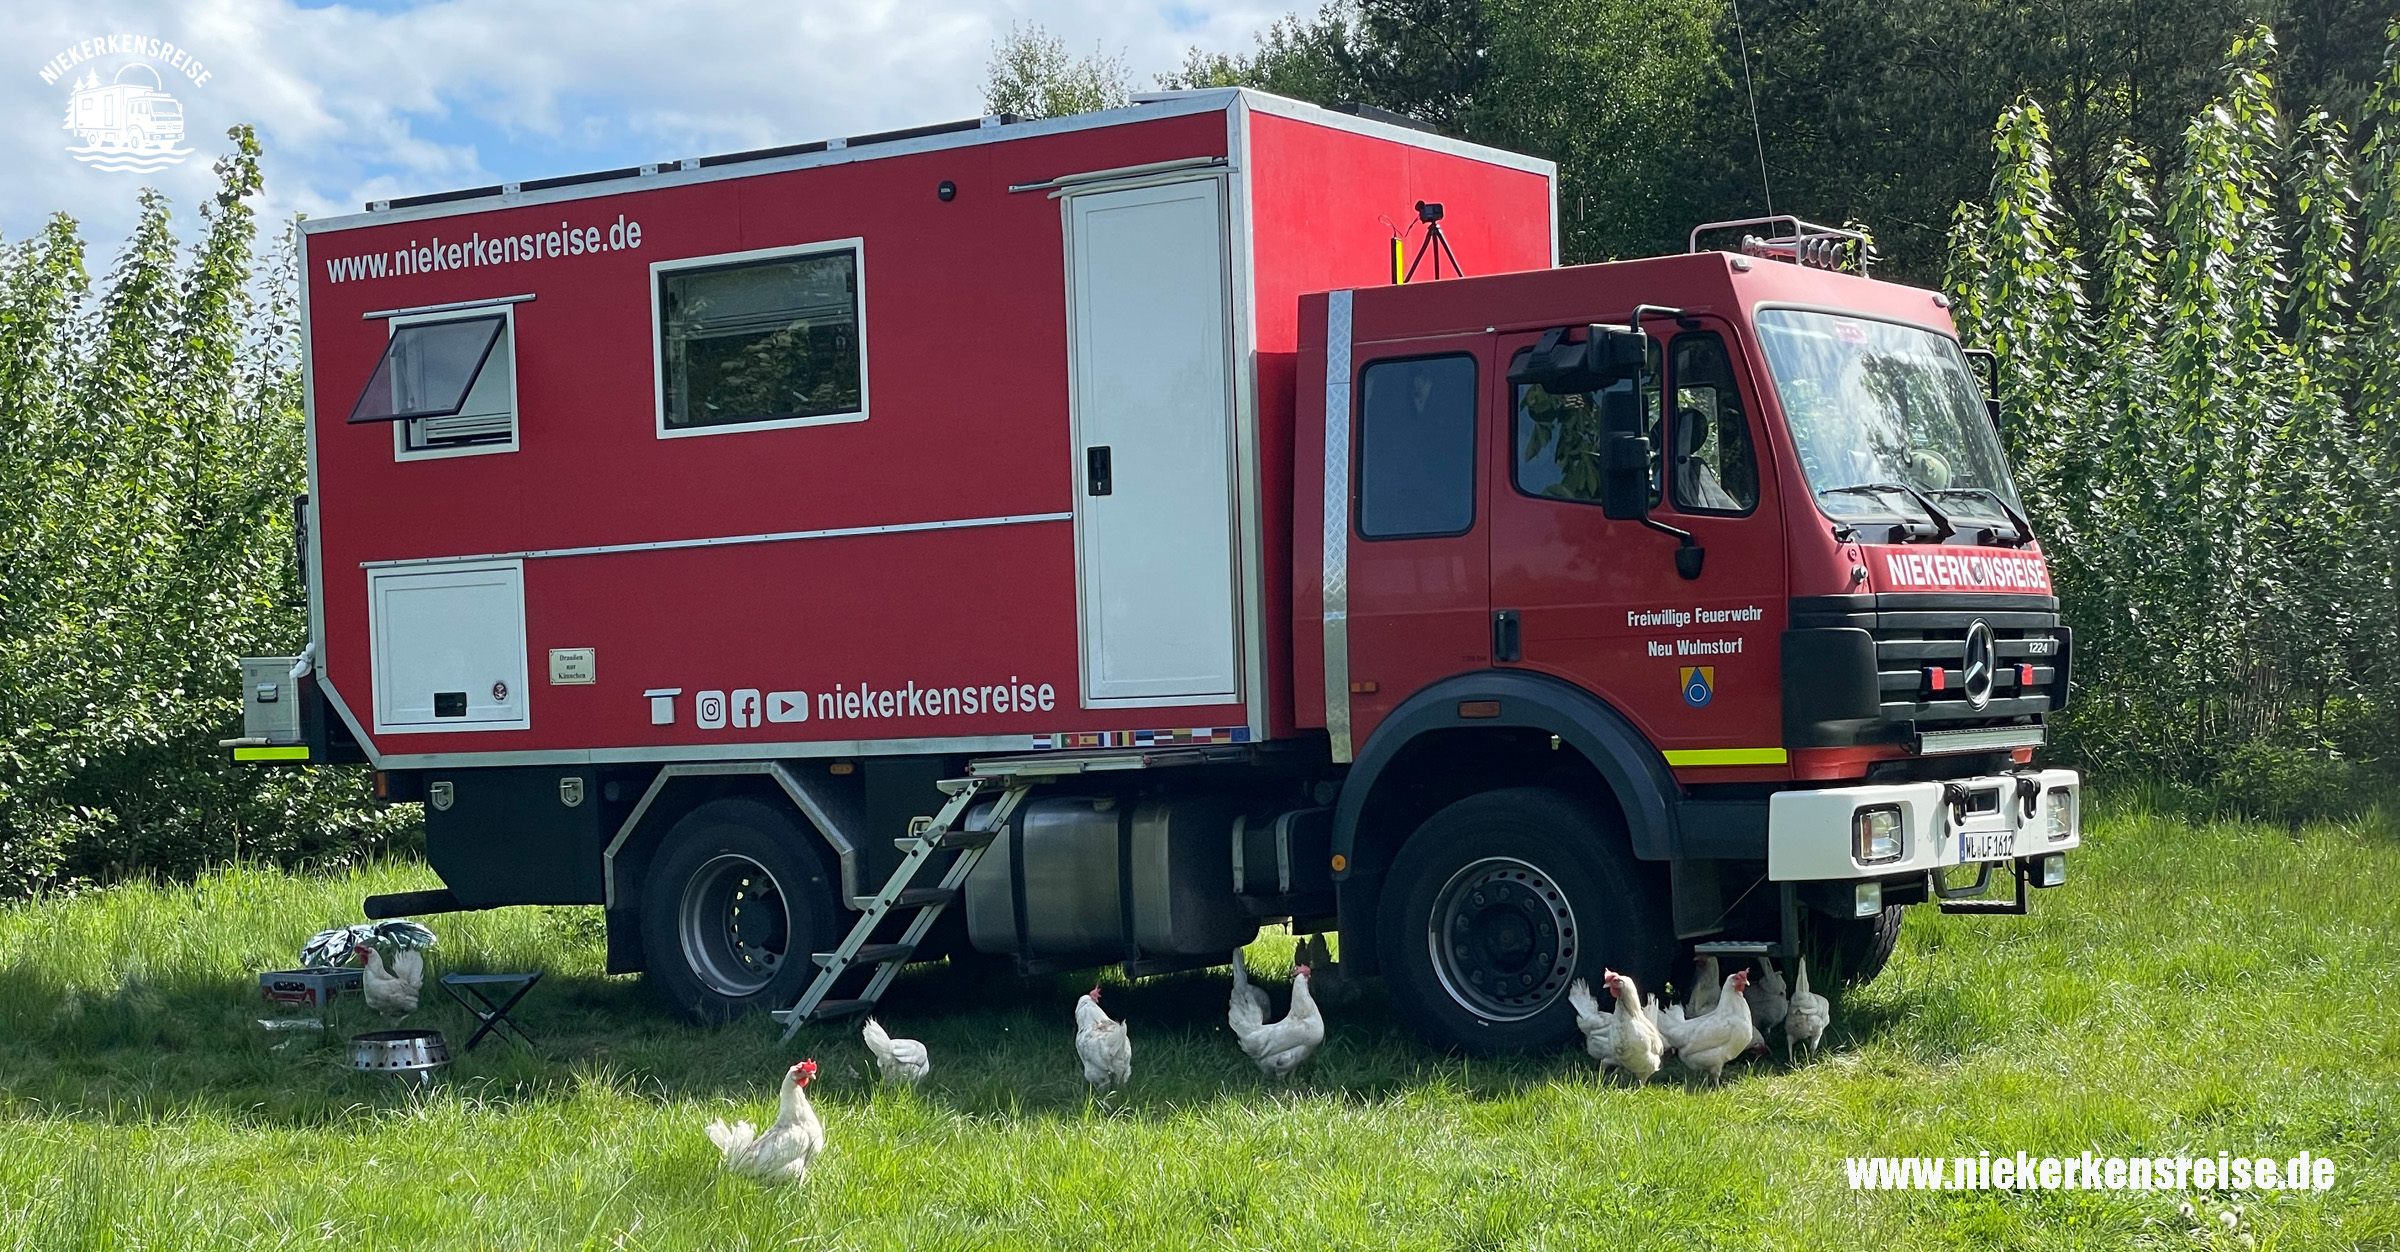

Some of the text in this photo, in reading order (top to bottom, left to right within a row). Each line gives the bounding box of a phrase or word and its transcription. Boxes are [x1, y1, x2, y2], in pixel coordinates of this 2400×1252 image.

[326, 214, 642, 284] www.niekerkensreise.de
[1627, 605, 1763, 628] Freiwillige Feuerwehr
[1647, 637, 1743, 657] Neu Wulmstorf
[2028, 642, 2048, 654] 1224
[817, 675, 1056, 720] niekerkensreise
